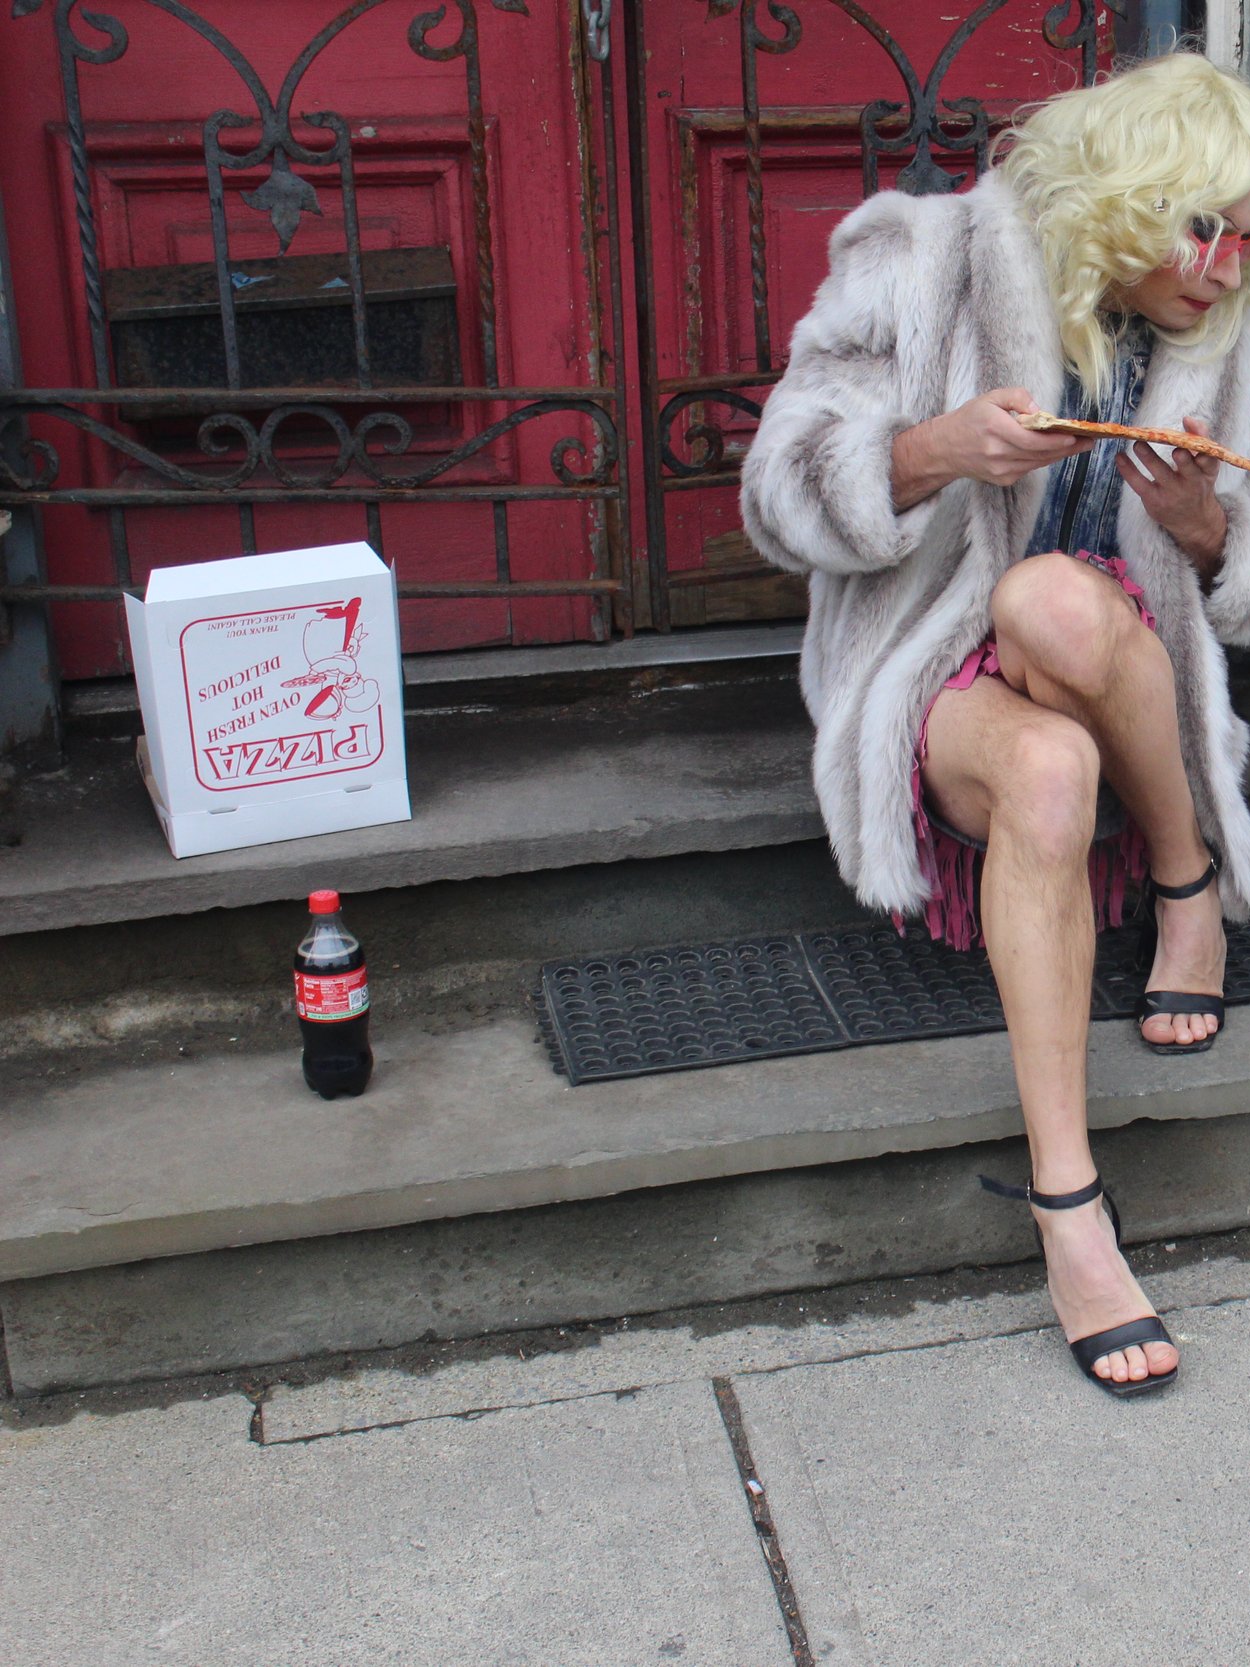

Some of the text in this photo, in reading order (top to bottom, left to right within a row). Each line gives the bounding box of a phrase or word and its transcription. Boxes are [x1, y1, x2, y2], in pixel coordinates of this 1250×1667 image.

[207, 612, 296, 631] PLEASE CALL AGAIN!
[226, 624, 279, 639] THANK YOU!
[197, 655, 282, 703] DELICIOUS
[231, 684, 265, 711] HOT
[207, 690, 302, 743] OVEN FRESH
[201, 723, 371, 781] PIZZA
